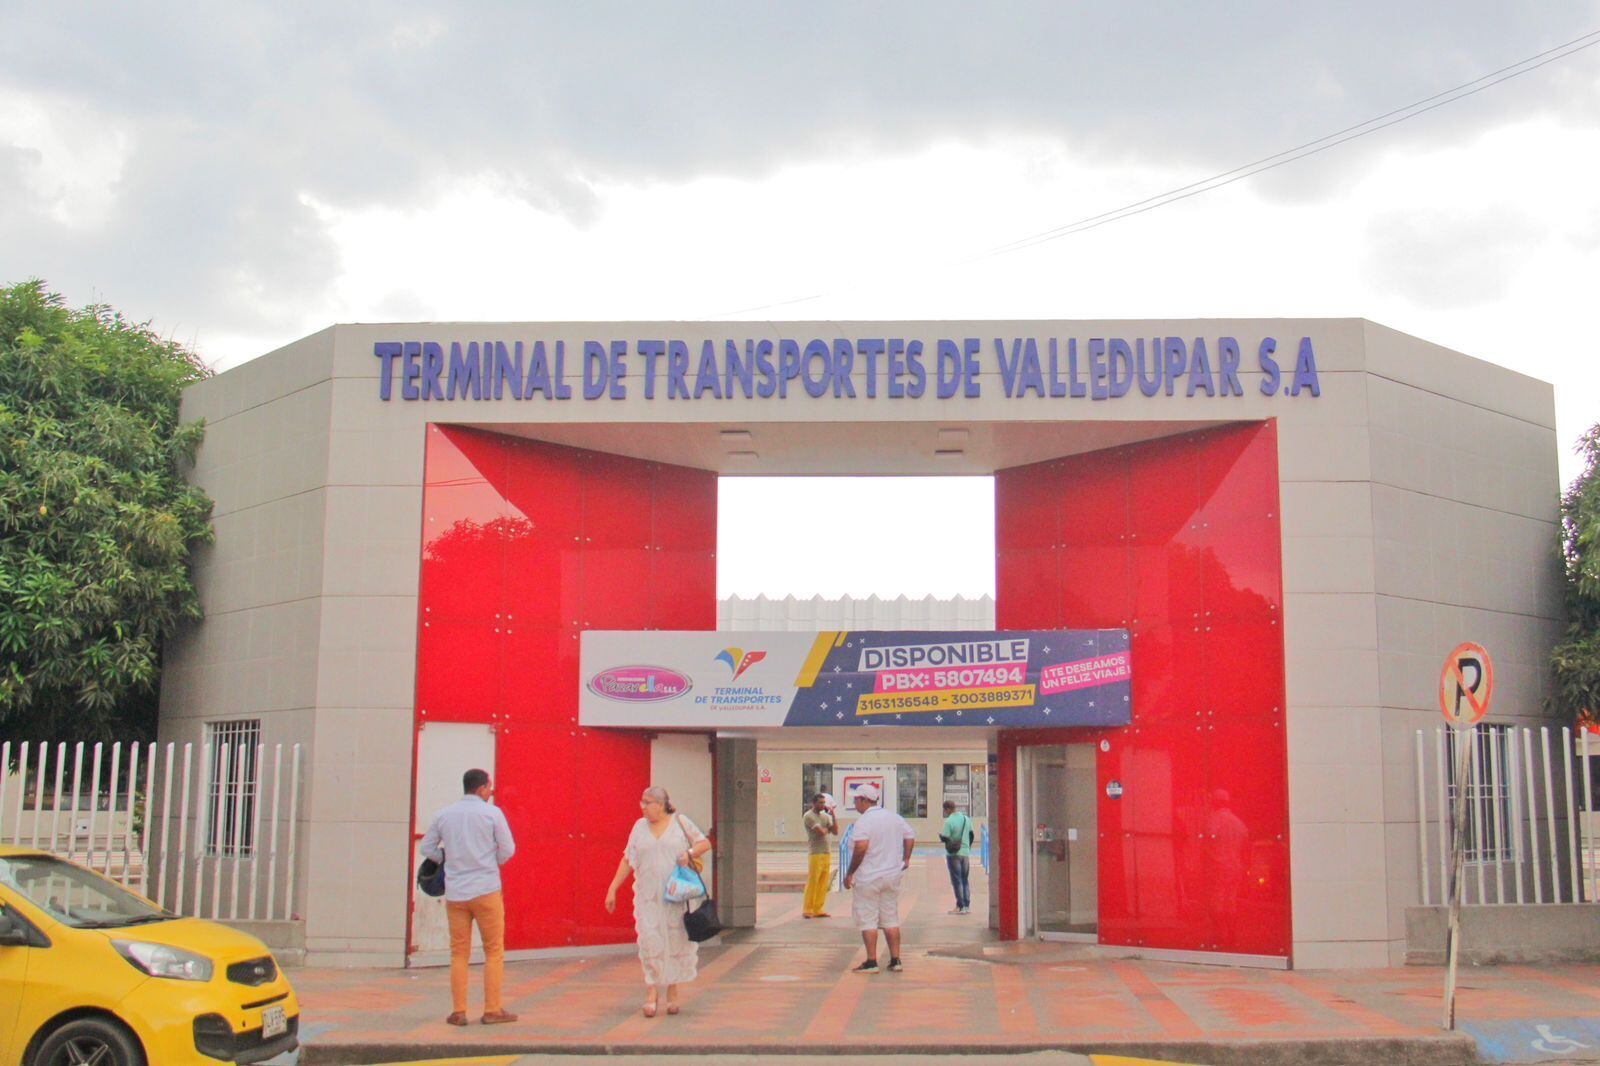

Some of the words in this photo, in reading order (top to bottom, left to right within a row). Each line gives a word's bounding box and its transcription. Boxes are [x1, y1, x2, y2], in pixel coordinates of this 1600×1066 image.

[374, 341, 572, 401] TERMINAL
[583, 341, 627, 400] DE
[637, 339, 927, 399] TRANSPORTES
[937, 338, 980, 399] DE
[994, 337, 1244, 400] VALLEDUPAR
[864, 641, 1027, 669] DISPONIBLE
[1065, 656, 1125, 675] DESEAMOS
[881, 672, 930, 690] PBX:
[934, 667, 1023, 688] 5807494
[1042, 679, 1059, 689] UN
[1061, 673, 1091, 686] FELIZ
[695, 696, 709, 704] DE
[710, 695, 782, 704] TRANSPORTES
[714, 687, 765, 695] TERMINAL
[860, 695, 940, 710] 3163136548
[951, 689, 1032, 704] 3003889371
